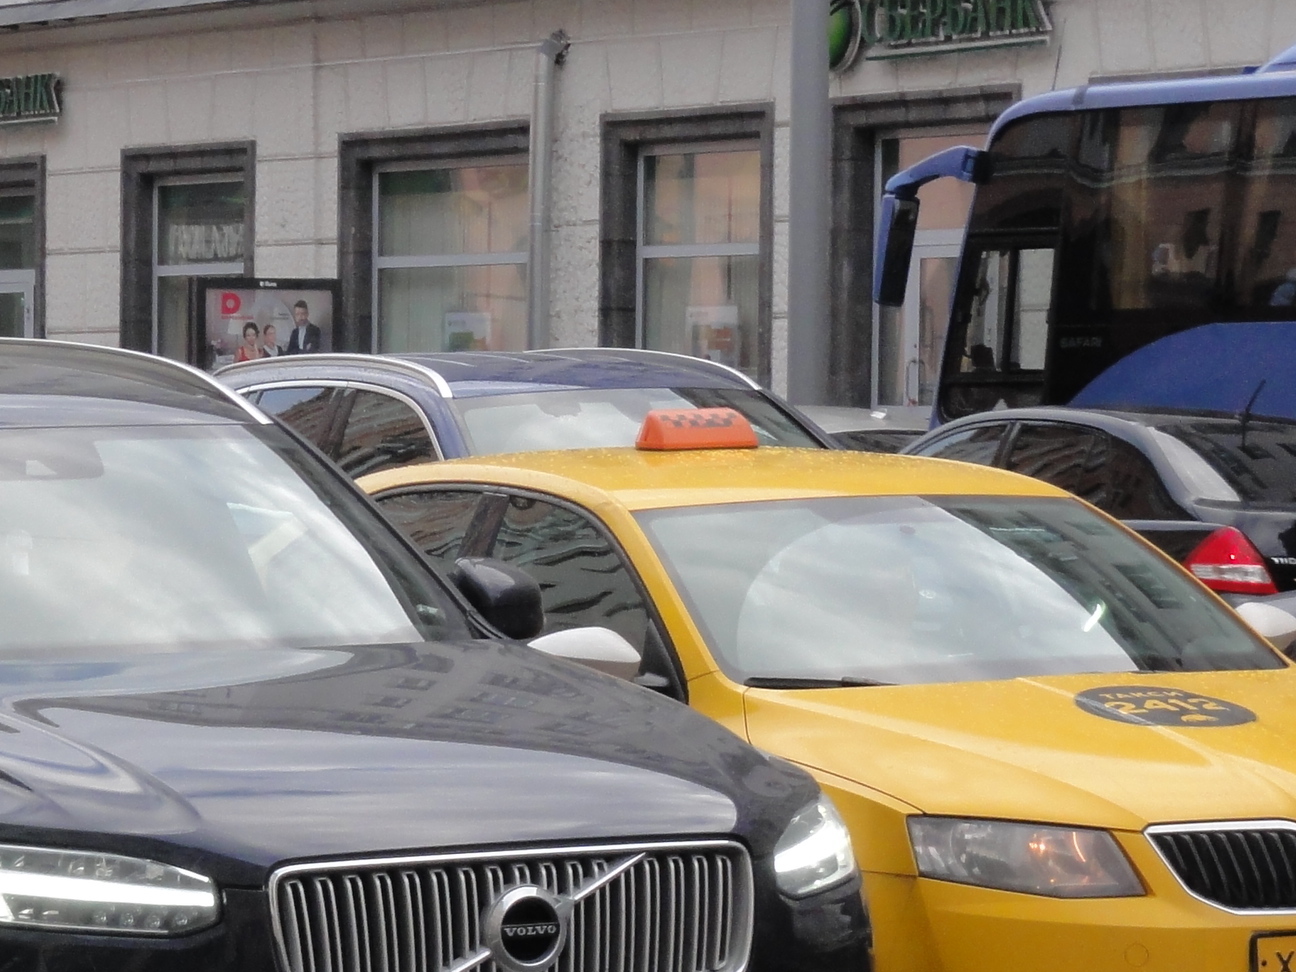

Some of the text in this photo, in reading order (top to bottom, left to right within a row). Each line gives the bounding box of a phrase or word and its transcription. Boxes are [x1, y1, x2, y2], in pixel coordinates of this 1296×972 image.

[1099, 691, 1184, 700] ТАКСИ
[1105, 698, 1230, 714] 2412
[504, 925, 557, 937] VOLVO
